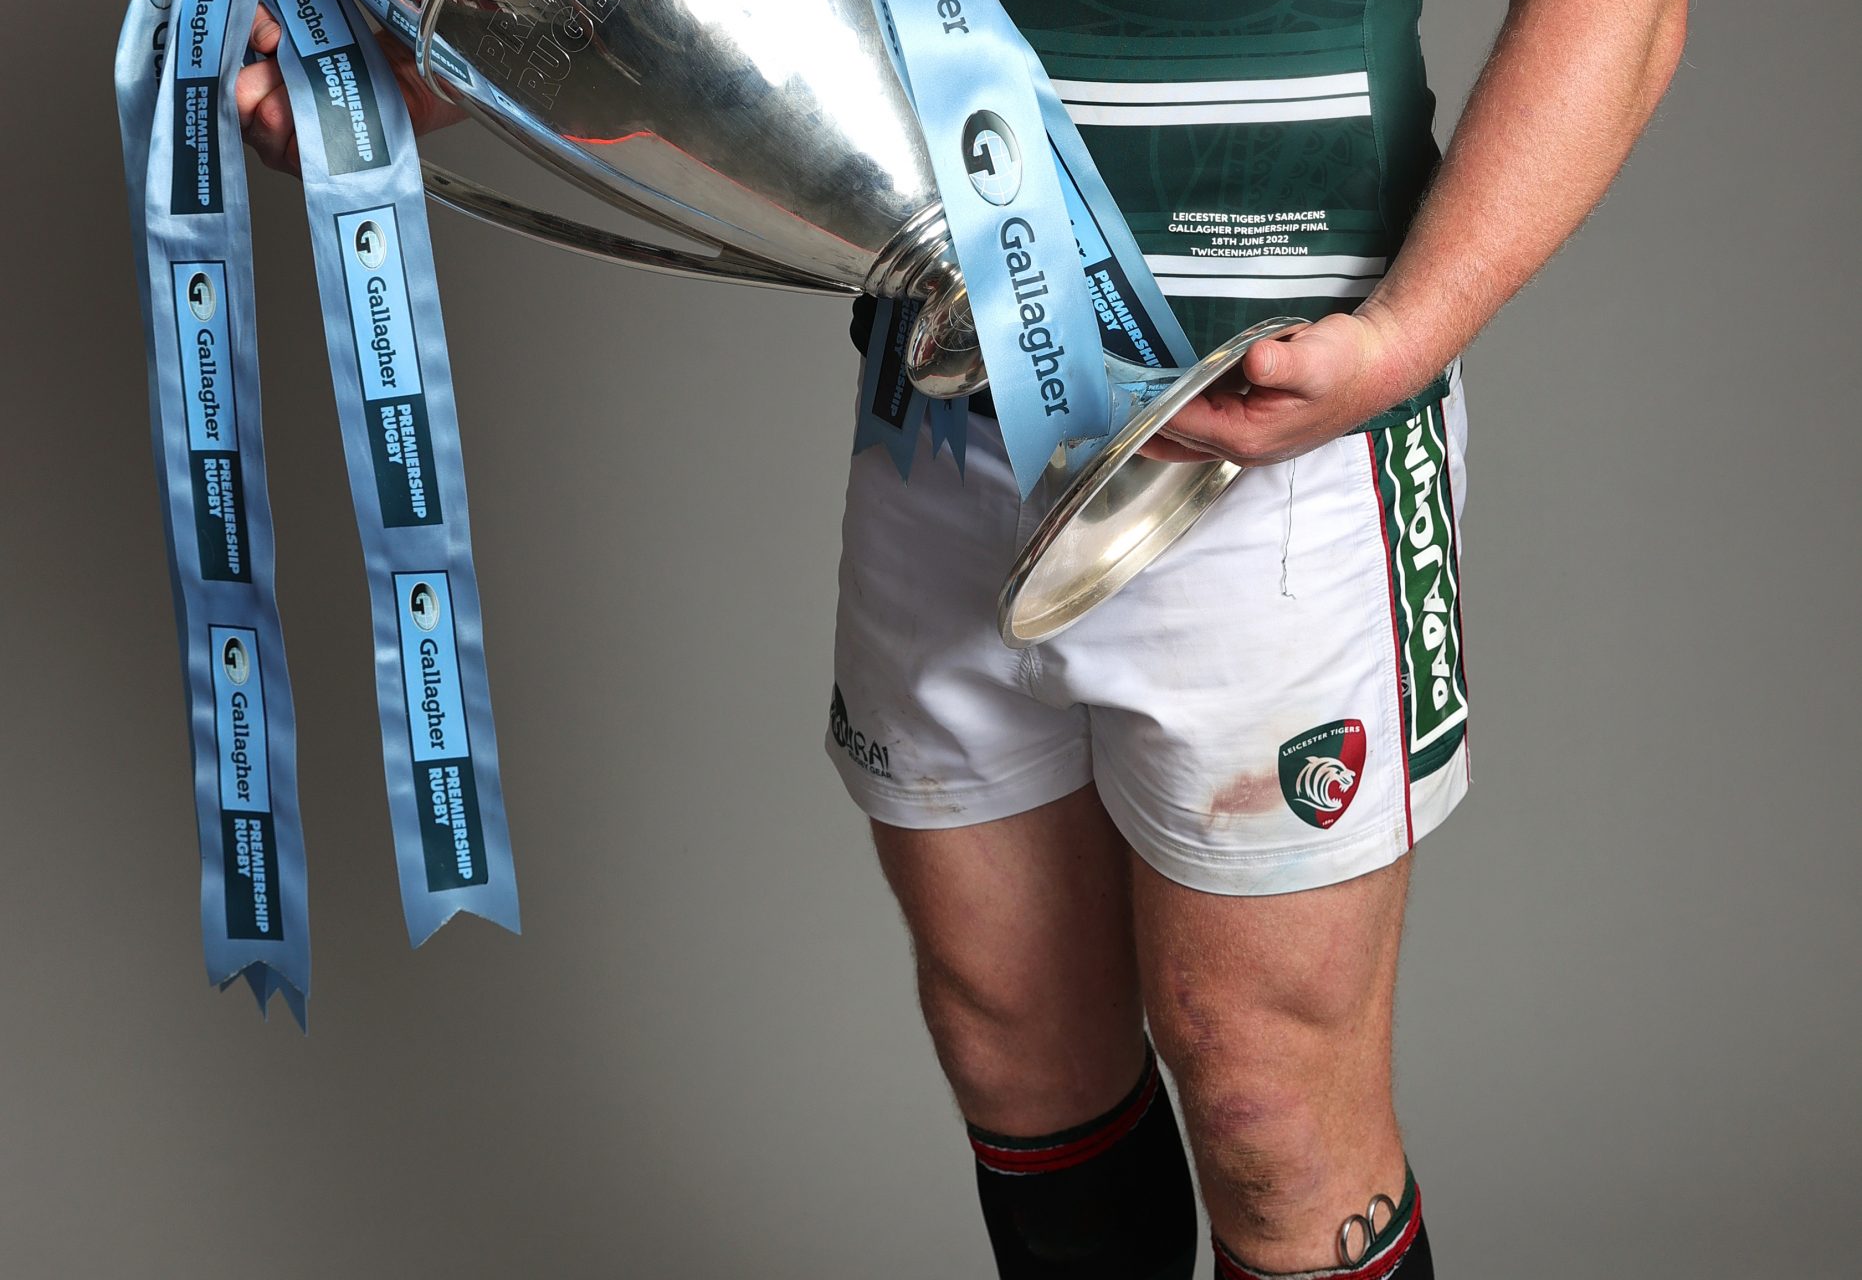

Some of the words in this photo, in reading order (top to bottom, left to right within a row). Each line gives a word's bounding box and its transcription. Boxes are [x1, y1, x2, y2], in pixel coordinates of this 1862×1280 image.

[185, 87, 197, 149] RUGBY
[316, 56, 346, 109] RUGBY
[333, 52, 373, 163] PREMIERSHIP
[198, 86, 210, 206] PREMIERSHIP
[1168, 224, 1232, 234] GALLAGHER
[1234, 224, 1300, 234] PREMIERSHIP
[1300, 222, 1329, 232] FINAL
[1172, 212, 1228, 223] LEICESTER
[1230, 214, 1266, 224] TIGERS
[1267, 214, 1274, 222] V
[1275, 210, 1326, 222] SARACENS
[1190, 247, 1262, 257] TWICKENHAM
[1263, 246, 1308, 255] STADIUM
[1211, 236, 1237, 246] 18TH
[1239, 237, 1264, 246] JUNE
[1266, 235, 1289, 244] 2022
[366, 276, 397, 389] Gallagher
[1000, 216, 1070, 418] Gallagher
[1094, 269, 1163, 368] PREMIERSHI
[196, 328, 219, 441] Gallagher
[380, 405, 403, 465] RUGBY
[204, 458, 222, 519] RUGBY
[218, 458, 240, 576] PREMIERSHIP
[397, 404, 427, 520] PREMIERSHIP
[1404, 413, 1443, 571] JOHN
[419, 637, 445, 752] Gallagher
[1422, 570, 1450, 711] PAPA
[230, 692, 250, 802] Gallagher
[1282, 732, 1328, 756] LEICESTER
[1330, 726, 1360, 736] TIGERS
[234, 818, 250, 878] RUGBY
[428, 767, 449, 827] RUGBY
[444, 765, 473, 880] PREMIERSHIP
[250, 819, 269, 934] PREMIERSHIP
